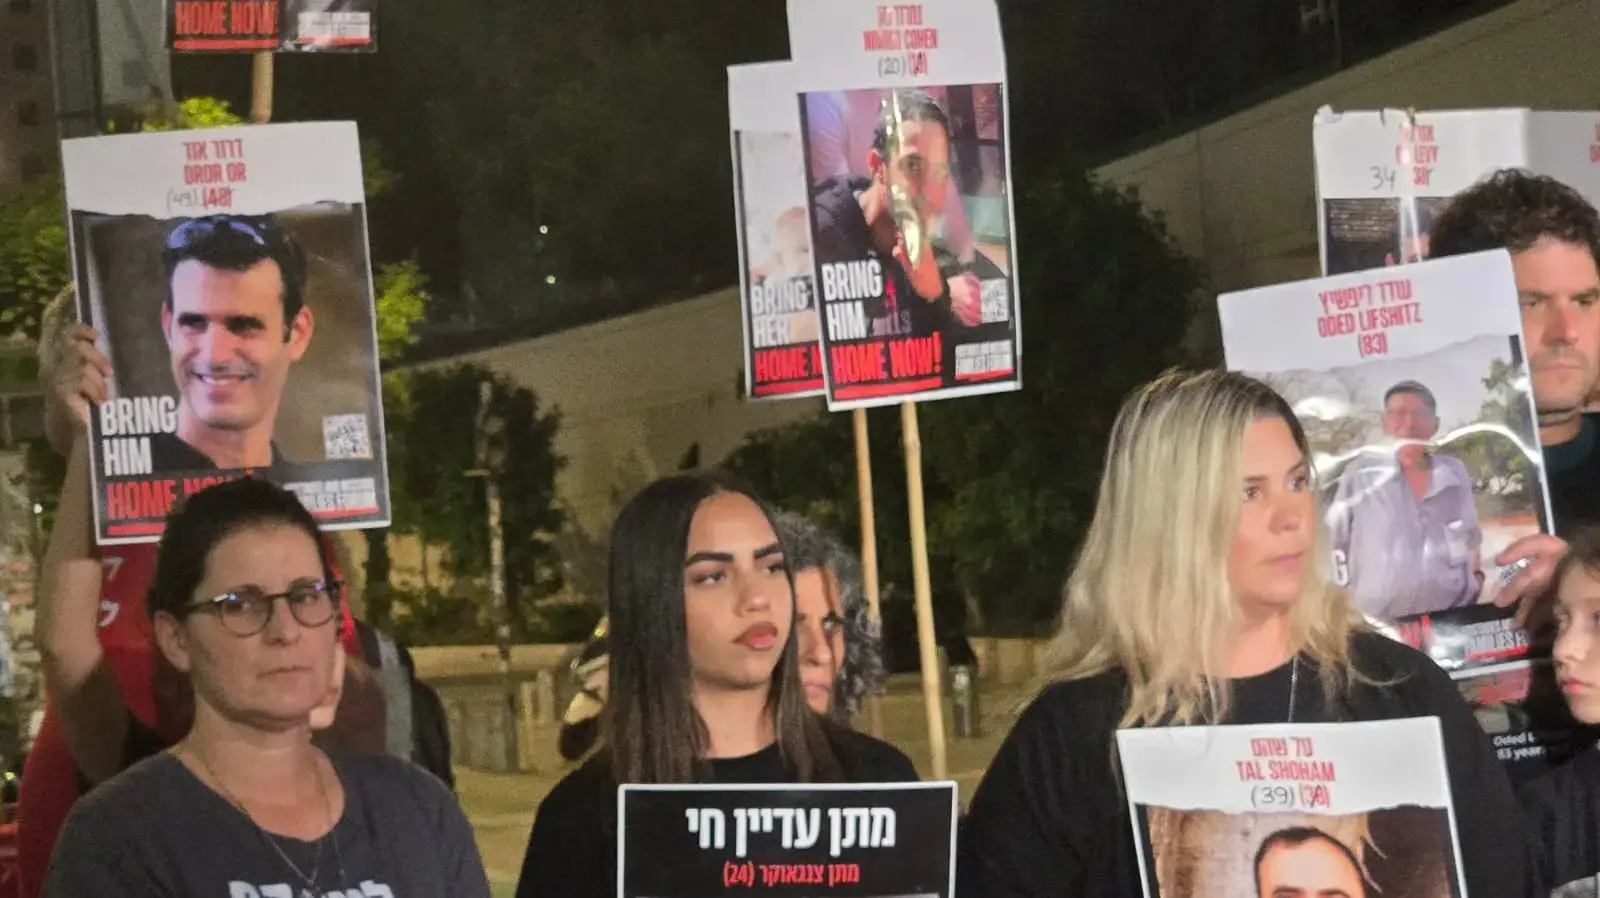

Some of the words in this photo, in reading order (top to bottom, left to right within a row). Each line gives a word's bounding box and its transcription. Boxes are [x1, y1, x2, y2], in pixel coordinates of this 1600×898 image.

[175, 1, 227, 34] HOME
[905, 28, 938, 49] COHEN
[878, 56, 906, 78] (20)
[211, 138, 243, 160] דרור
[184, 163, 222, 185] DROR
[226, 162, 247, 182] OR
[1370, 165, 1396, 192] 34
[822, 259, 883, 301] BRING
[1376, 278, 1412, 303] עודד
[751, 279, 809, 316] BRING
[753, 313, 790, 348] HER
[826, 300, 867, 341] HIM
[1317, 312, 1356, 338] ODED
[1358, 302, 1423, 332] LIFSHITZ
[830, 341, 888, 385] HOME
[888, 331, 943, 378] NOW!
[1357, 331, 1389, 358] (83)
[754, 346, 809, 384] HOME
[100, 396, 178, 435] BRING
[103, 438, 153, 476] HIM
[1289, 735, 1314, 757] טל
[1235, 760, 1266, 781] TAL
[1267, 760, 1336, 781] SHOHAM
[1250, 785, 1295, 808] (39)
[685, 808, 726, 850] חי
[733, 807, 821, 858] עדיין
[828, 807, 897, 858] מתן
[723, 860, 755, 888] (24)
[827, 863, 860, 888] מתן
